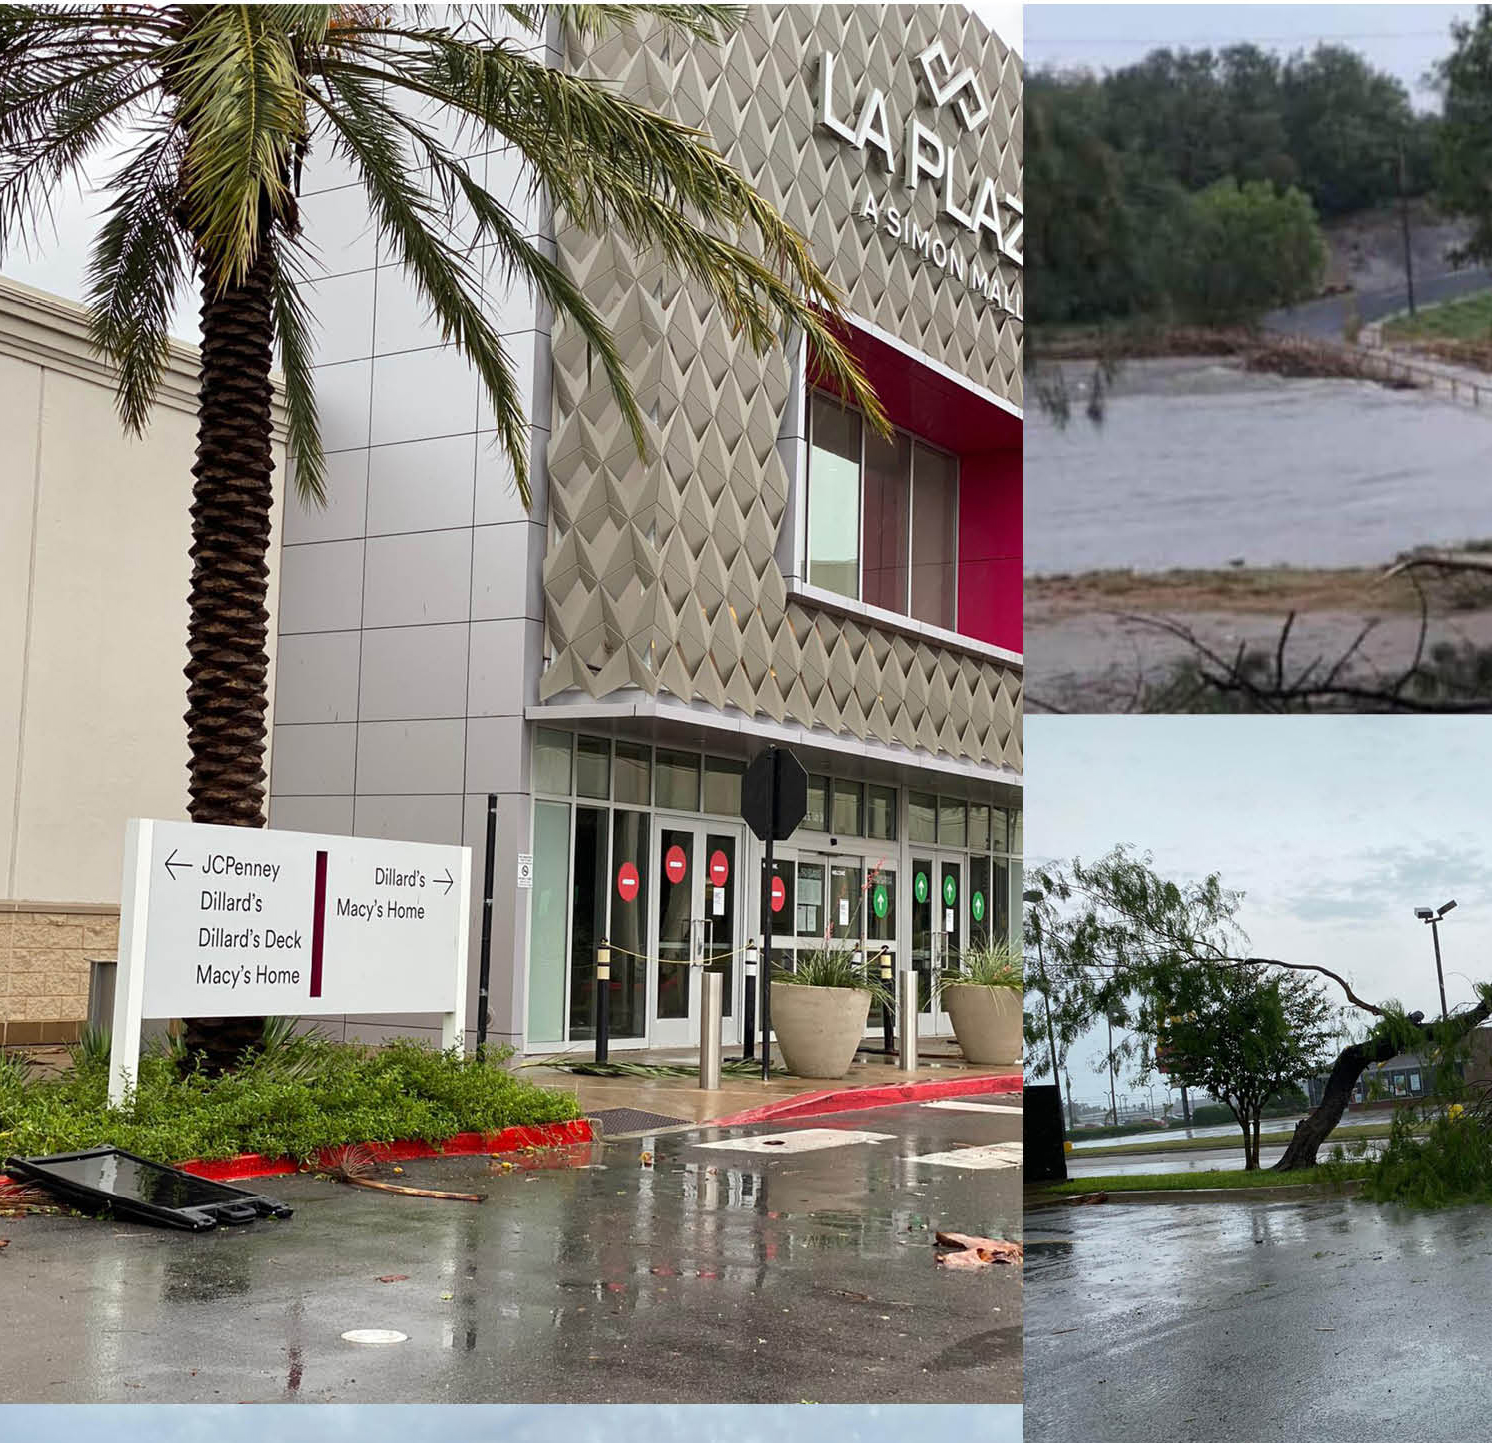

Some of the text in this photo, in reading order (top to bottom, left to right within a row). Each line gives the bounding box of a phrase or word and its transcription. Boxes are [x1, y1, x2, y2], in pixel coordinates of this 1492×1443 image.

[820, 49, 1023, 267] LA PLAZ
[860, 191, 1023, 321] A SIMON MALL
[201, 854, 281, 883] JCPenney
[375, 867, 426, 889] Dillard's
[200, 890, 263, 913] Dillard's
[336, 897, 425, 922] Macy's Home
[198, 927, 302, 949] Dillard's Deck
[196, 964, 300, 989] Macy's Home
